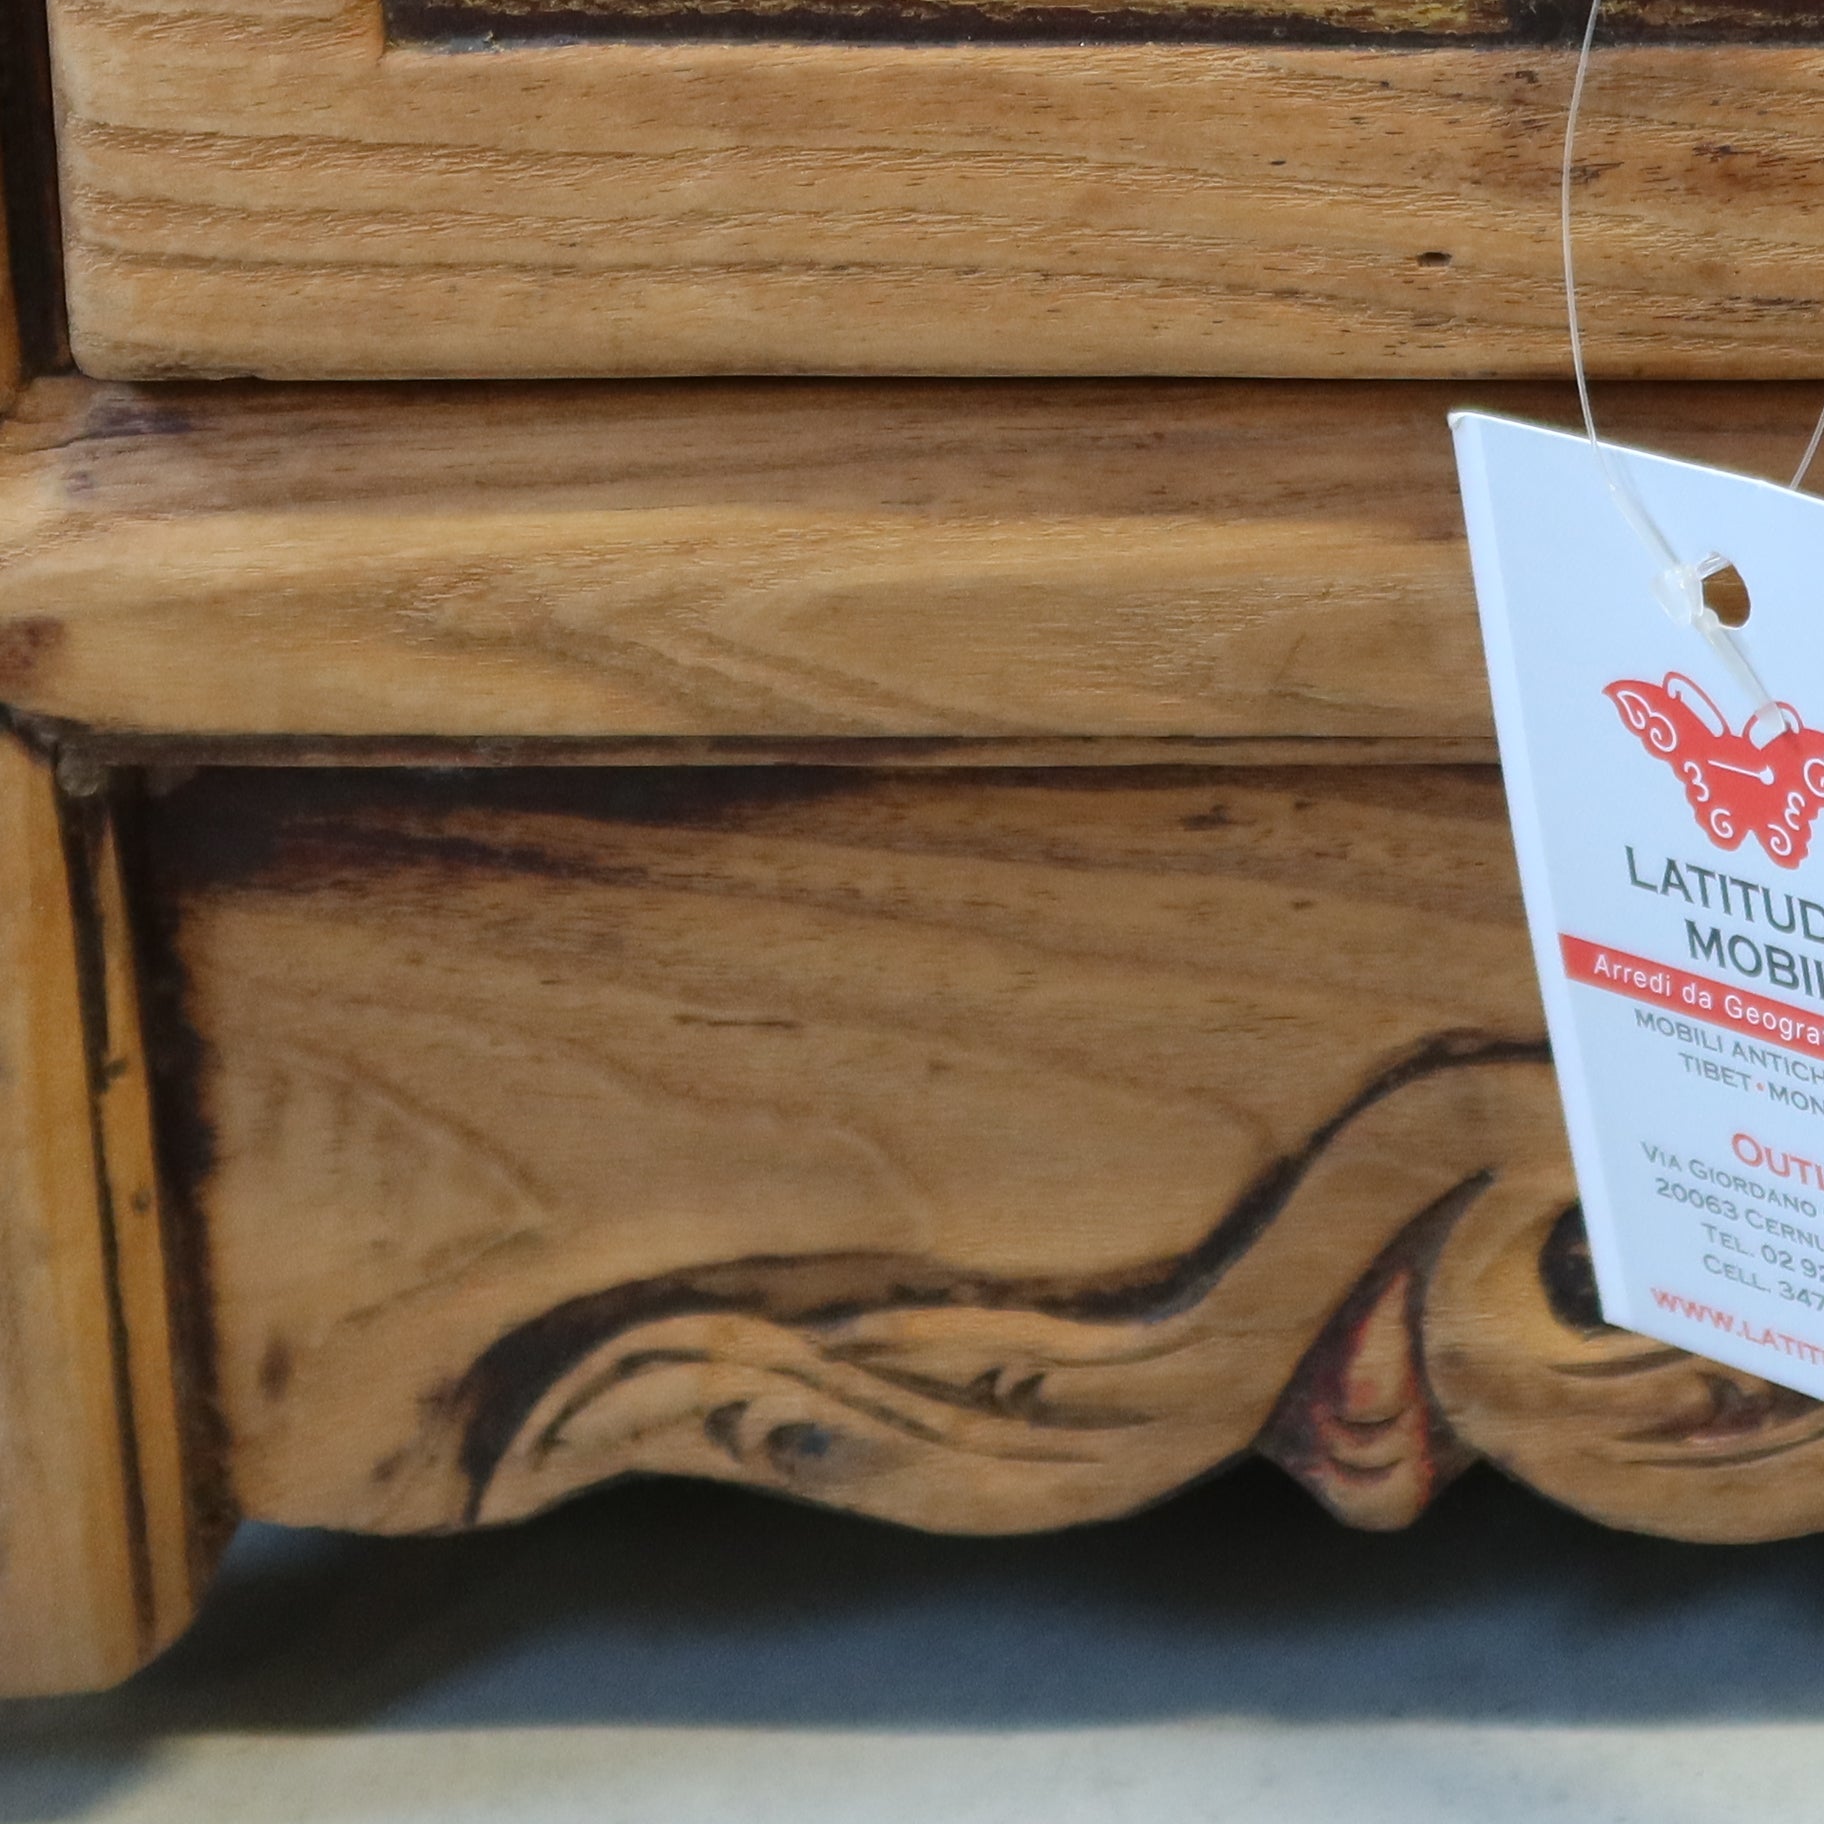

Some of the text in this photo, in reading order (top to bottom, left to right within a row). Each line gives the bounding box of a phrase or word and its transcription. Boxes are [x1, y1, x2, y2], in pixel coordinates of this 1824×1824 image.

[1593, 953, 1672, 997] Arredi
[1682, 982, 1713, 1011] da
[1634, 1008, 1724, 1054] MOBILI
[1640, 1141, 1682, 1172] VIA
[1689, 1158, 1818, 1219] GIORDANO
[1655, 1177, 1739, 1221] 20063
[1760, 1244, 1796, 1272] 02
